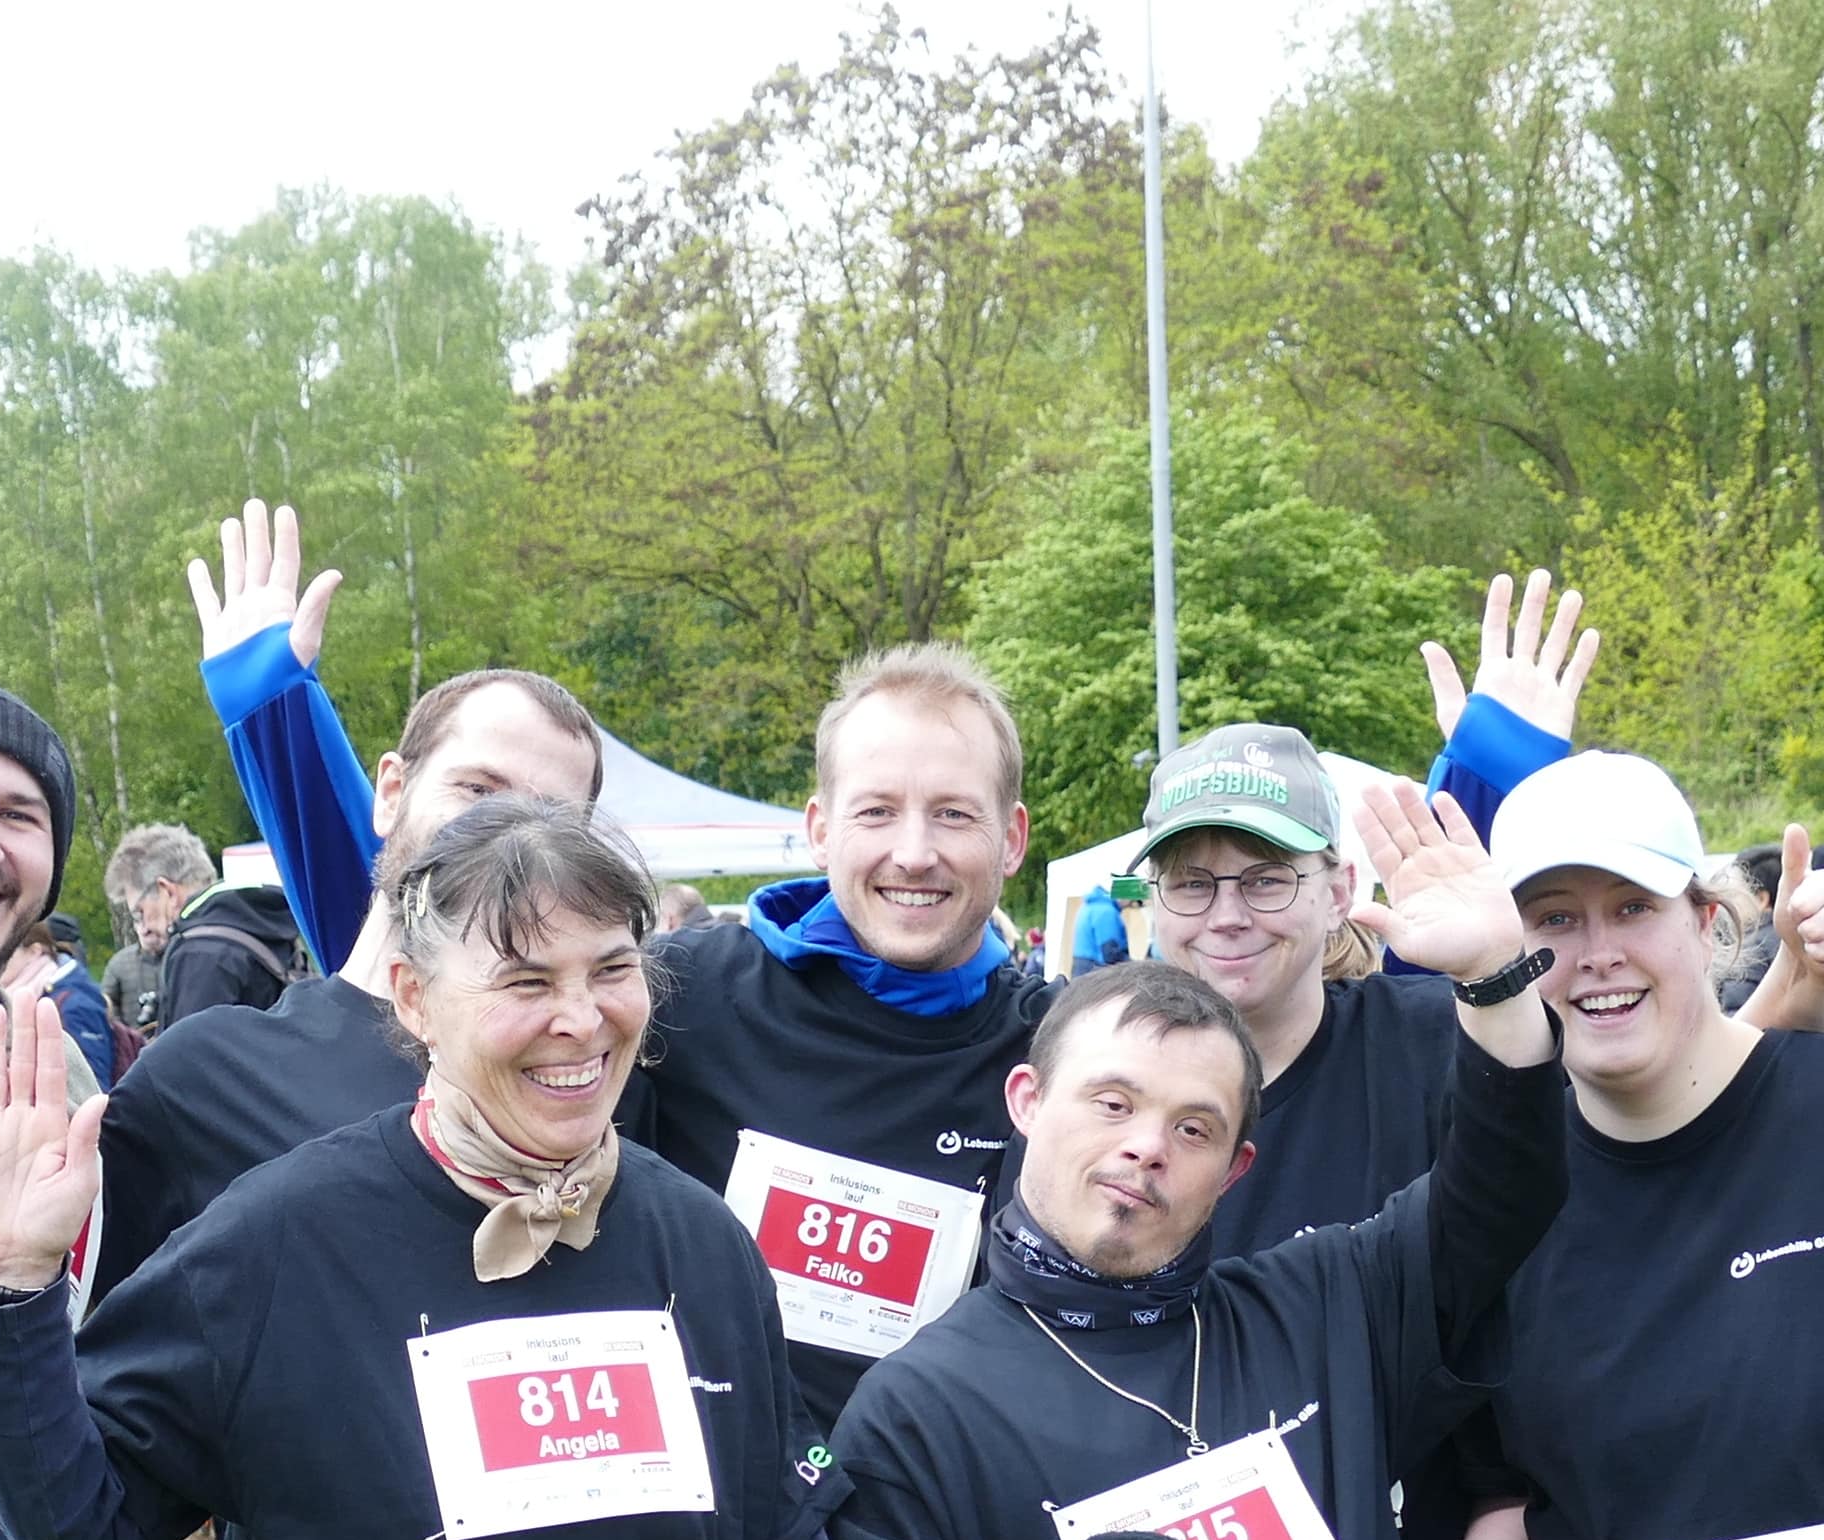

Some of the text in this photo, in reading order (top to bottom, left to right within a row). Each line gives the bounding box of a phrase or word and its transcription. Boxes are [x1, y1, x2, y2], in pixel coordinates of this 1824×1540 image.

[1160, 772, 1289, 814] WOLFSBURG
[797, 1203, 892, 1263] 816
[805, 1255, 864, 1286] Falko
[517, 1369, 620, 1428] 814
[539, 1429, 620, 1460] Angela
